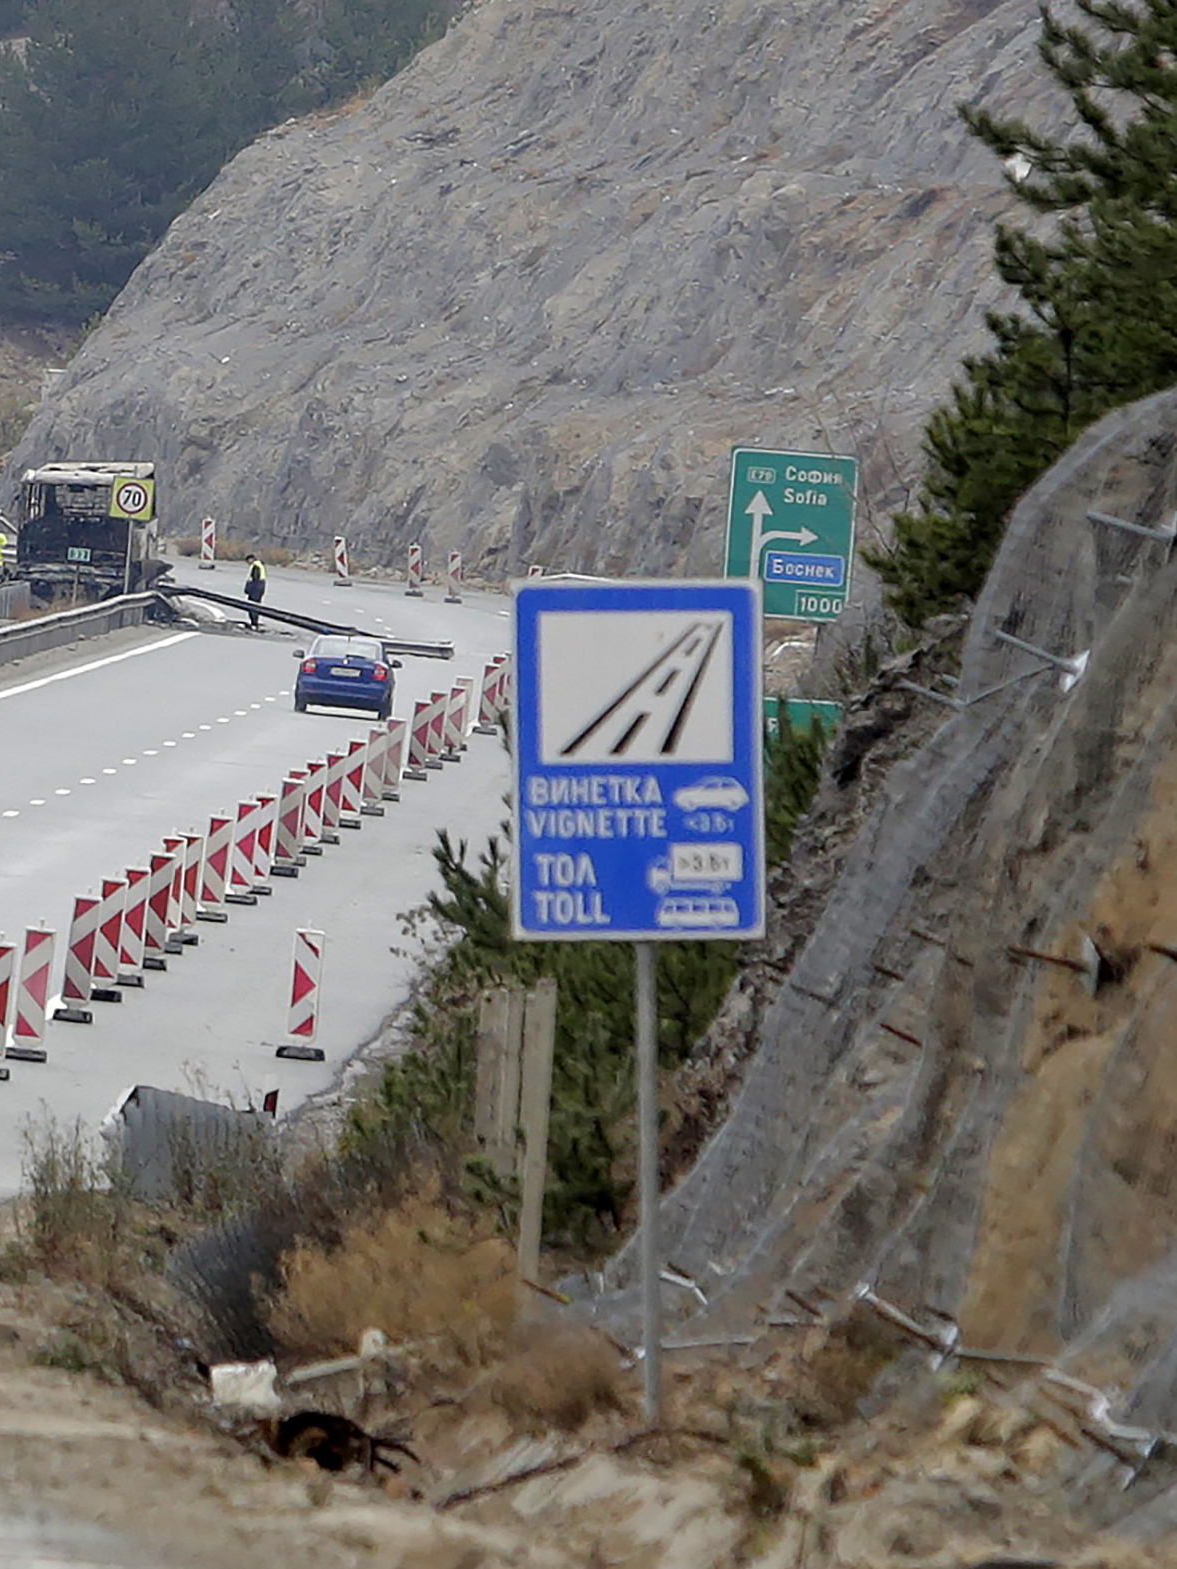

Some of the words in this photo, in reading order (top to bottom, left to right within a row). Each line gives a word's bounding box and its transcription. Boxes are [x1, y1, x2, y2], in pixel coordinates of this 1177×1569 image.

[785, 465, 842, 485] София
[124, 490, 142, 507] 70
[784, 488, 828, 506] Sofia
[772, 559, 835, 579] Боснек
[800, 597, 843, 614] 1000
[529, 775, 663, 805] ВИНЕТКА
[527, 807, 668, 838] VIGNETTE
[534, 852, 597, 887] ТОЛ
[534, 890, 611, 925] TOLL
